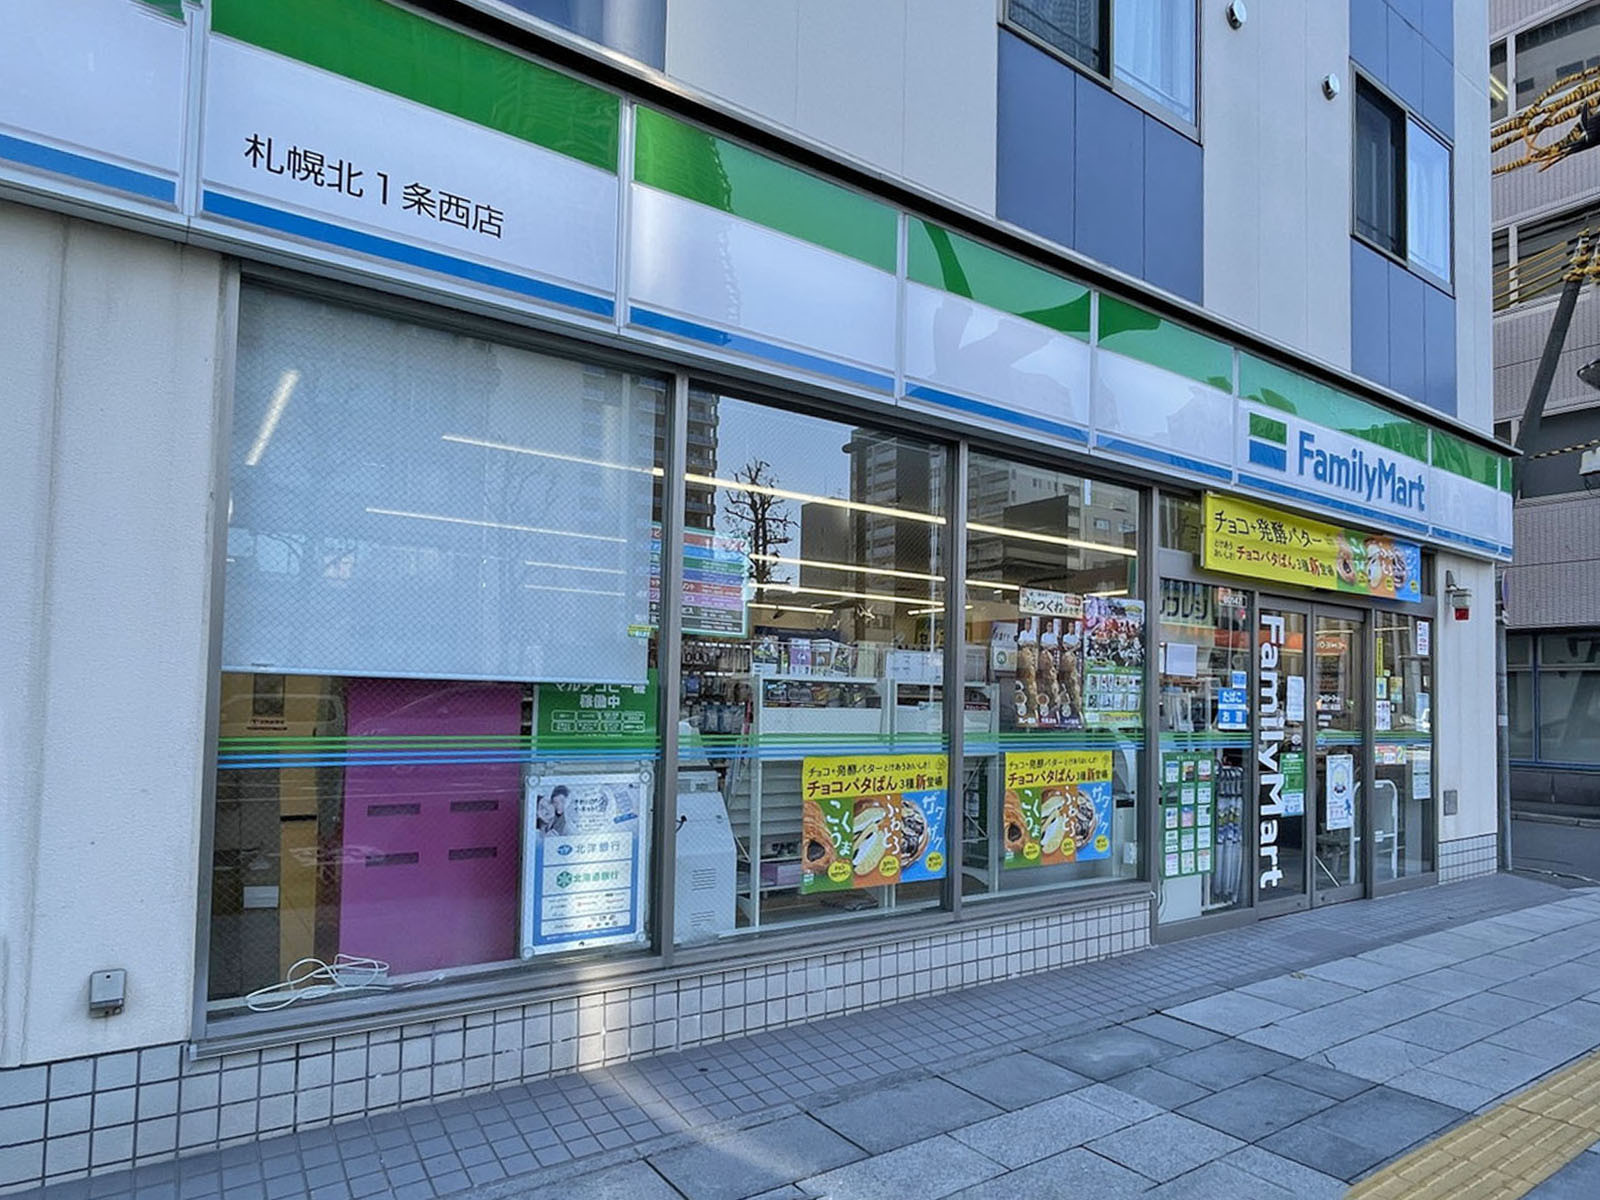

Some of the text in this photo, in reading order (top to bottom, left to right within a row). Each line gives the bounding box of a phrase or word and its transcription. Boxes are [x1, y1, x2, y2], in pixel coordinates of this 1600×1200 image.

[244, 133, 504, 239] 札幌北1条西店
[1298, 430, 1425, 511] FamilyMart
[1258, 613, 1285, 889] FamilyMart
